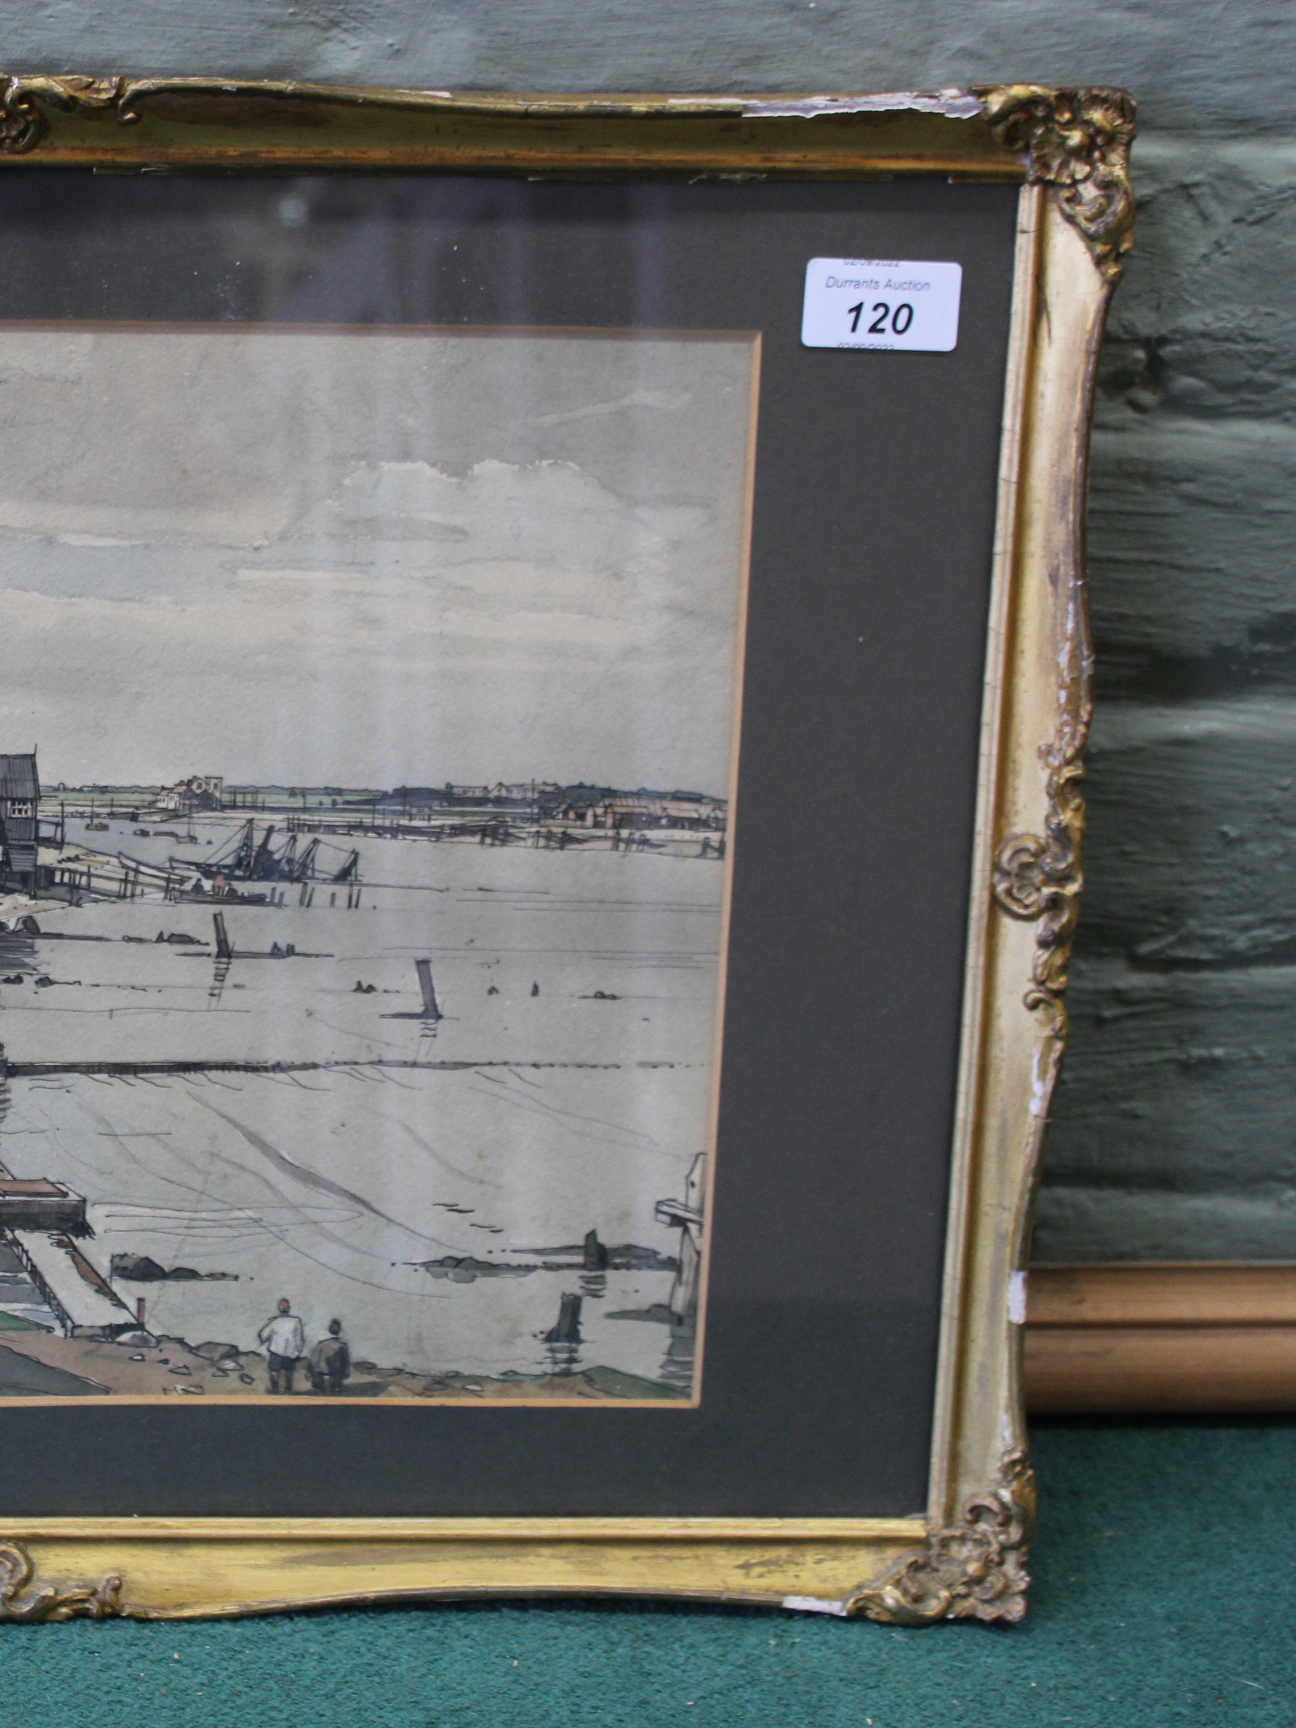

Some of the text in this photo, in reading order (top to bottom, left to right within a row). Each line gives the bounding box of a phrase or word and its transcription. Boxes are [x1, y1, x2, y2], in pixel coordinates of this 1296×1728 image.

[825, 276, 931, 292] Durrants Auction
[847, 301, 914, 335] 120
